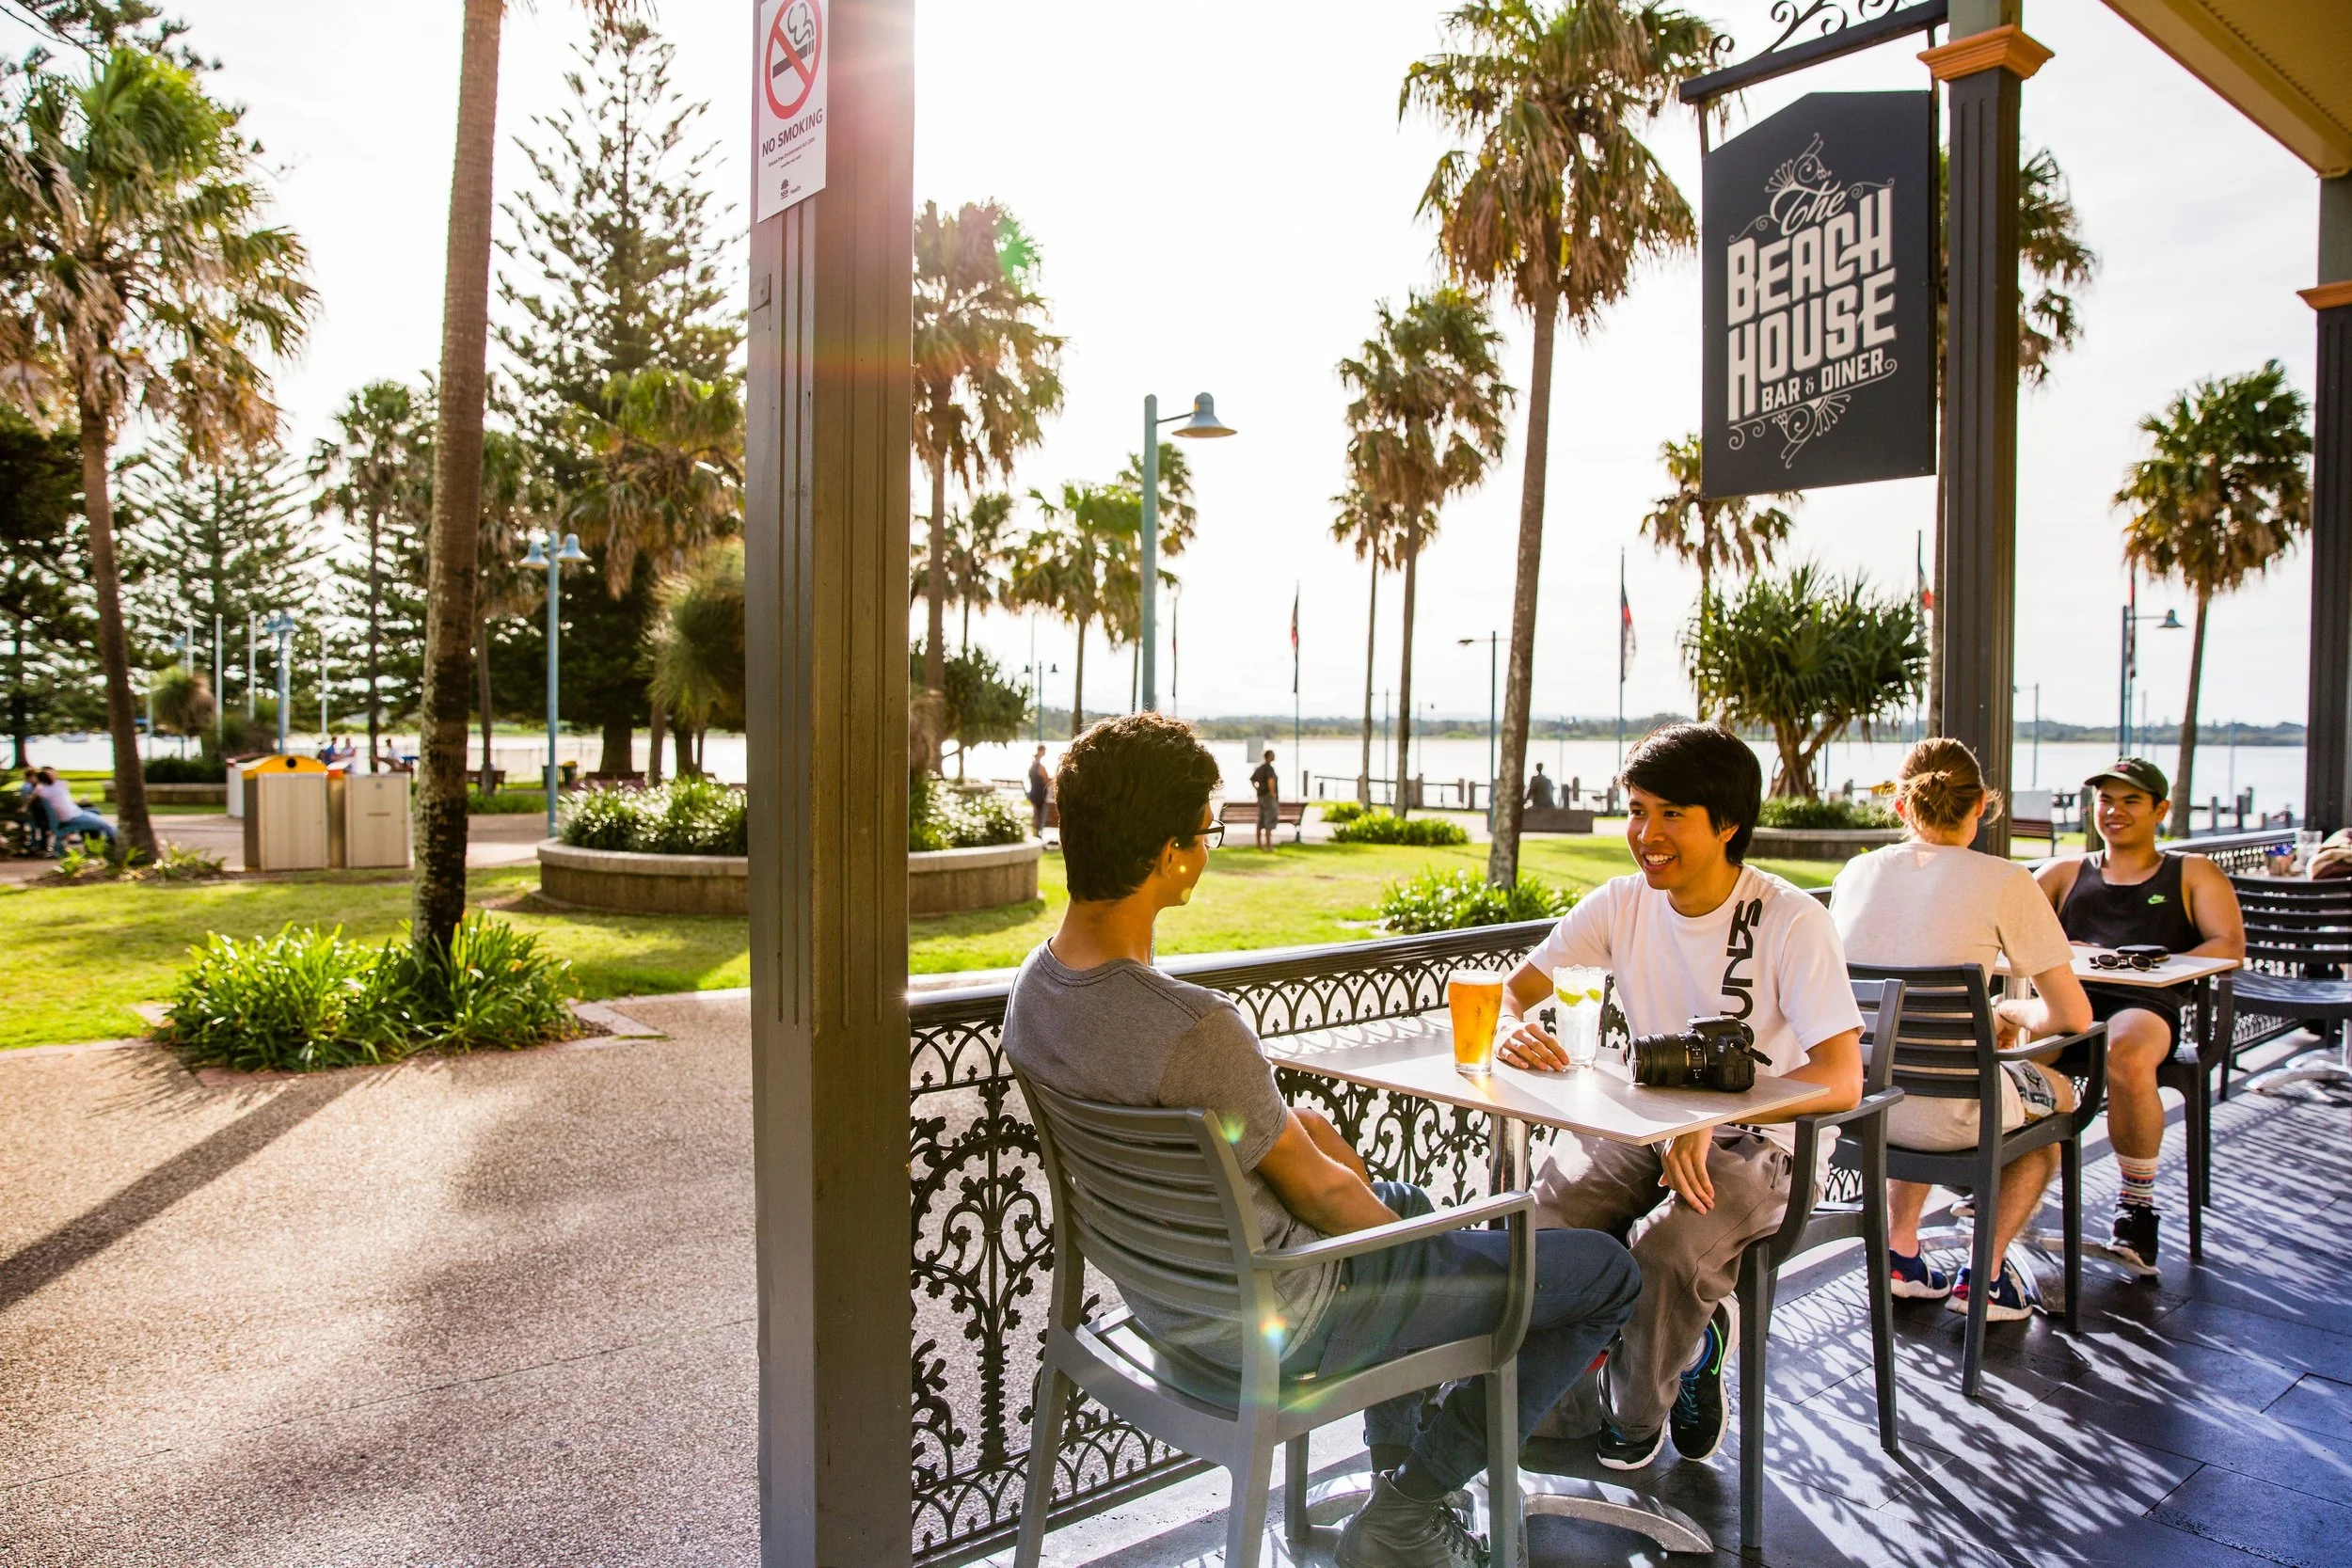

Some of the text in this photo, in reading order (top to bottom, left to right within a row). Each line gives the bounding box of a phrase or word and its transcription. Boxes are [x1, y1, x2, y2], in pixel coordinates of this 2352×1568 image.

[762, 109, 822, 157] NO SMOKING
[1770, 180, 1848, 236] The
[1727, 187, 1893, 327] BEACH
[1727, 267, 1896, 421] HOUSE
[1761, 347, 1884, 414] BAR & DINER
